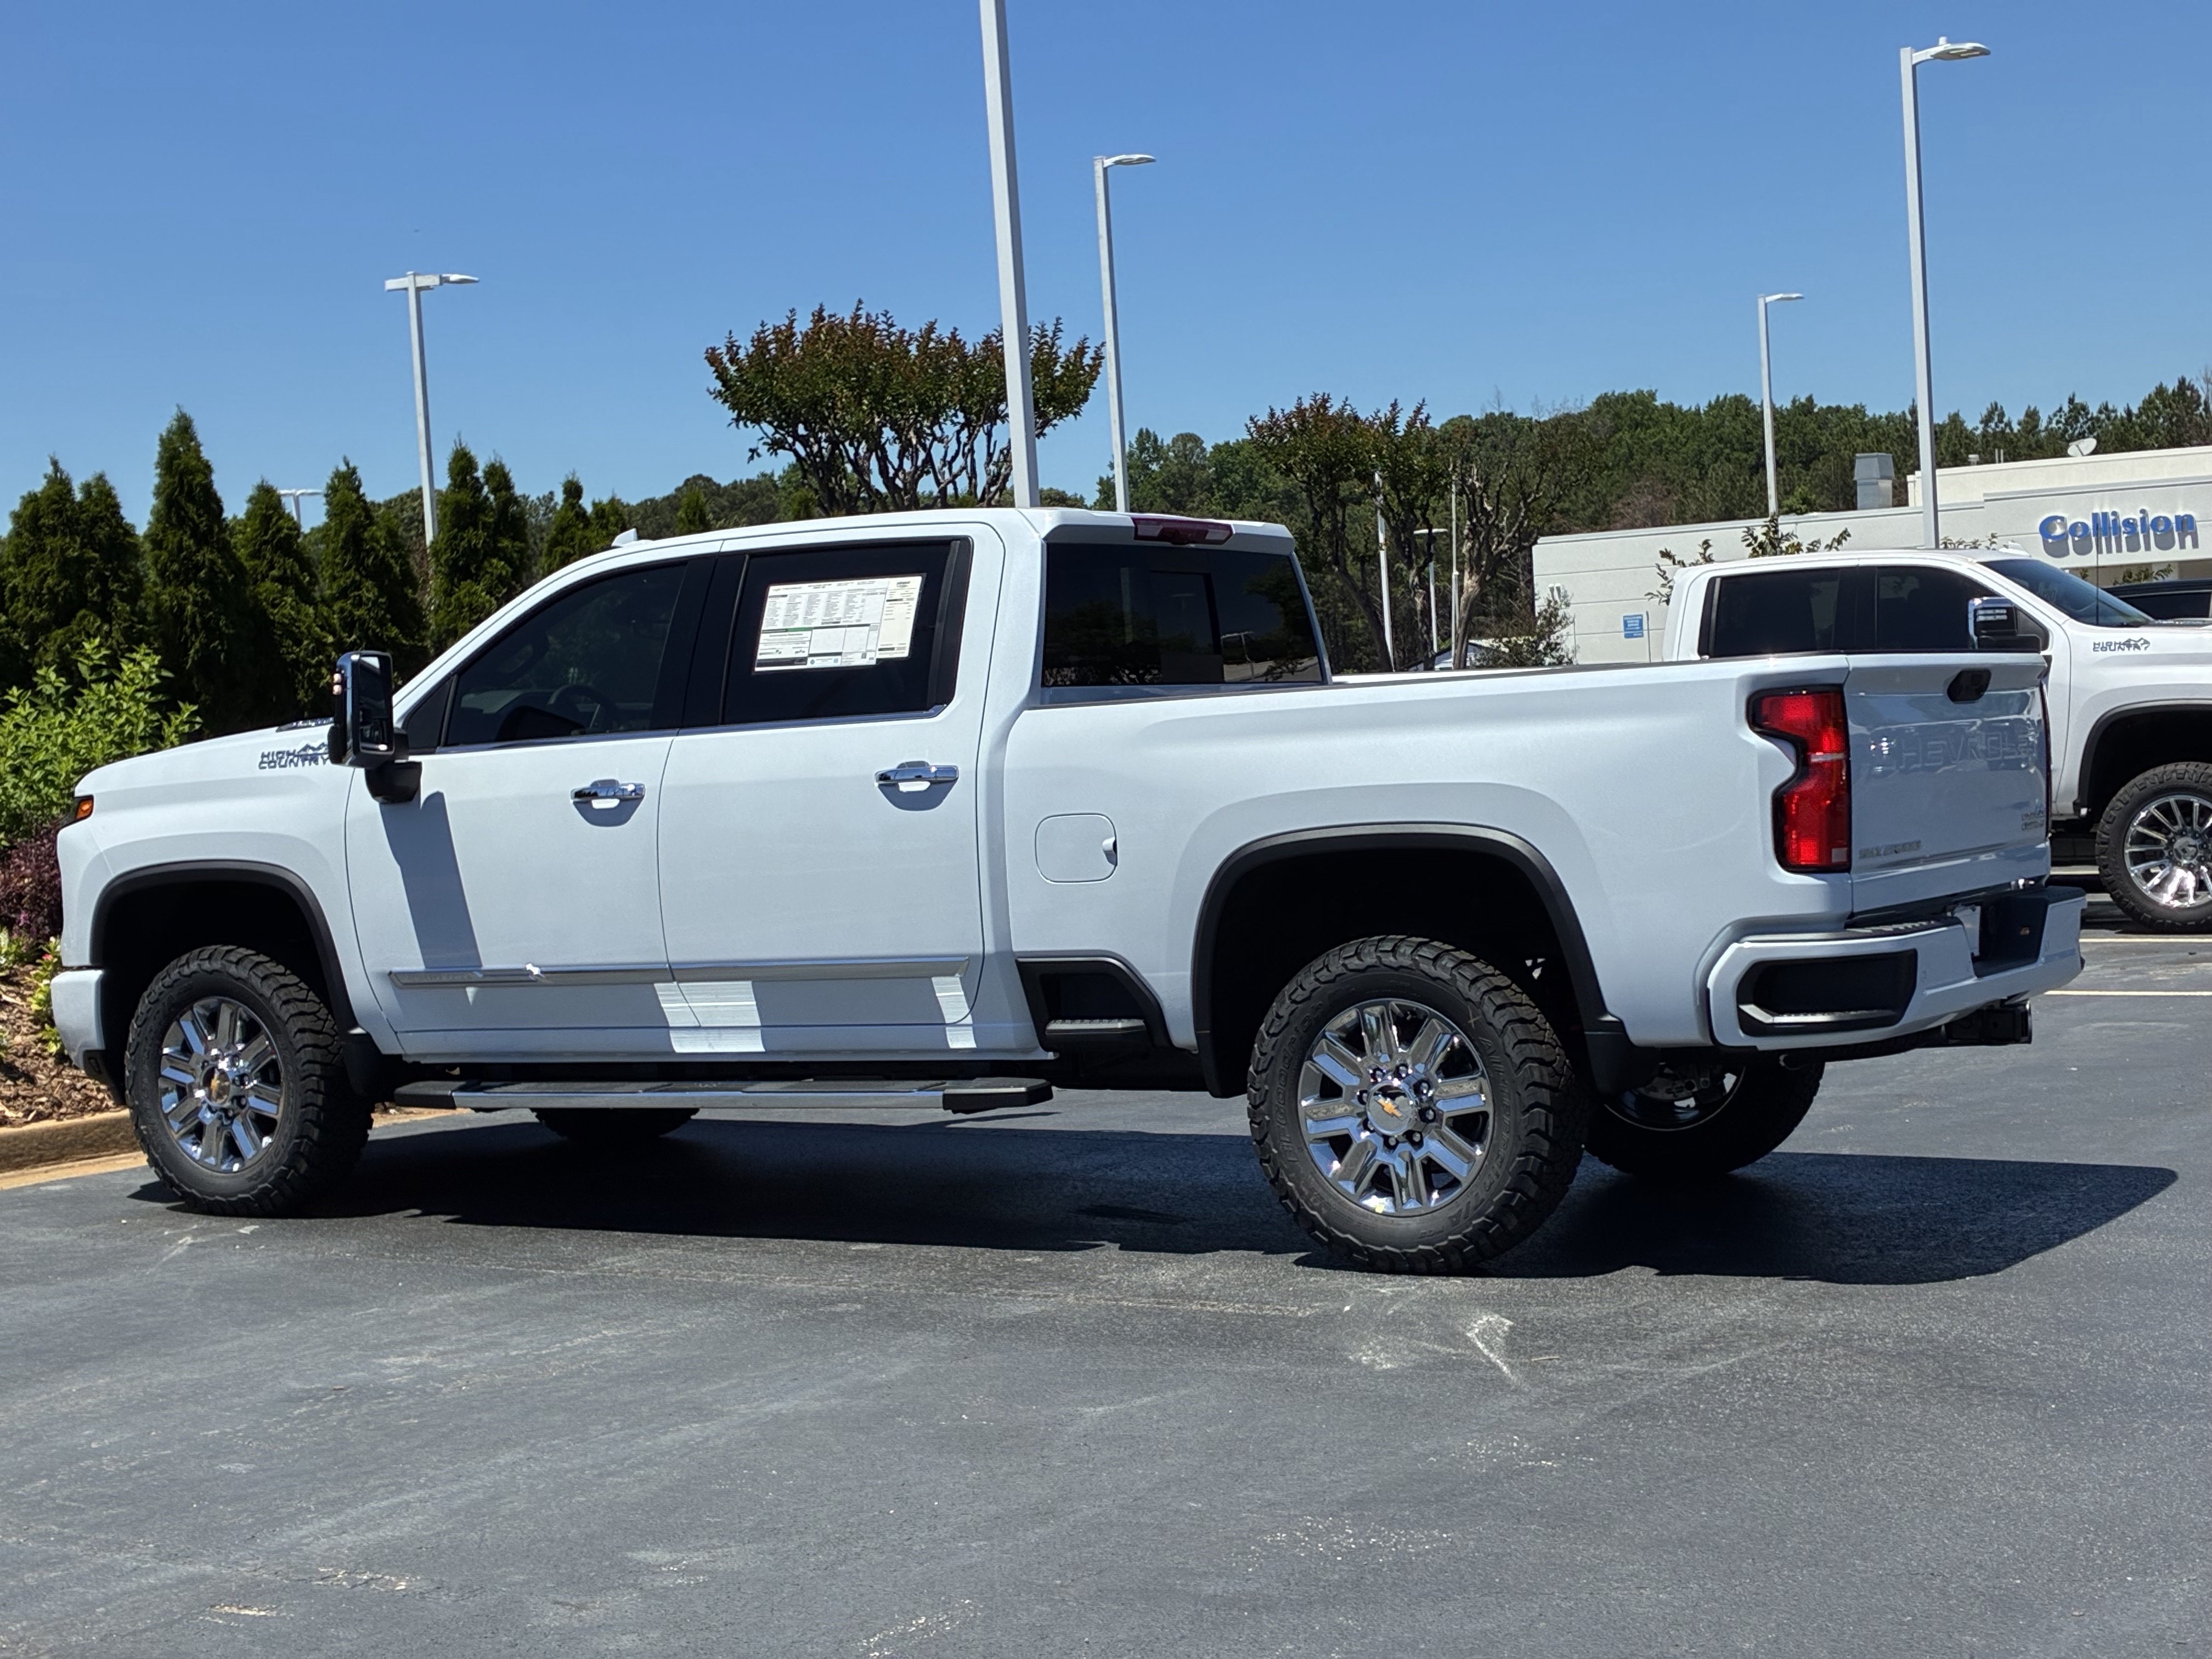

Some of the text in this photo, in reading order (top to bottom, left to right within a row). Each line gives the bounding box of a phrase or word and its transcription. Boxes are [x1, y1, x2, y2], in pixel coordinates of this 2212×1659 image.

[2039, 508, 2195, 542] Collision
[258, 754, 330, 769] COUNTRY
[261, 749, 297, 761] HIGH
[1867, 731, 2037, 771] HEVROLE
